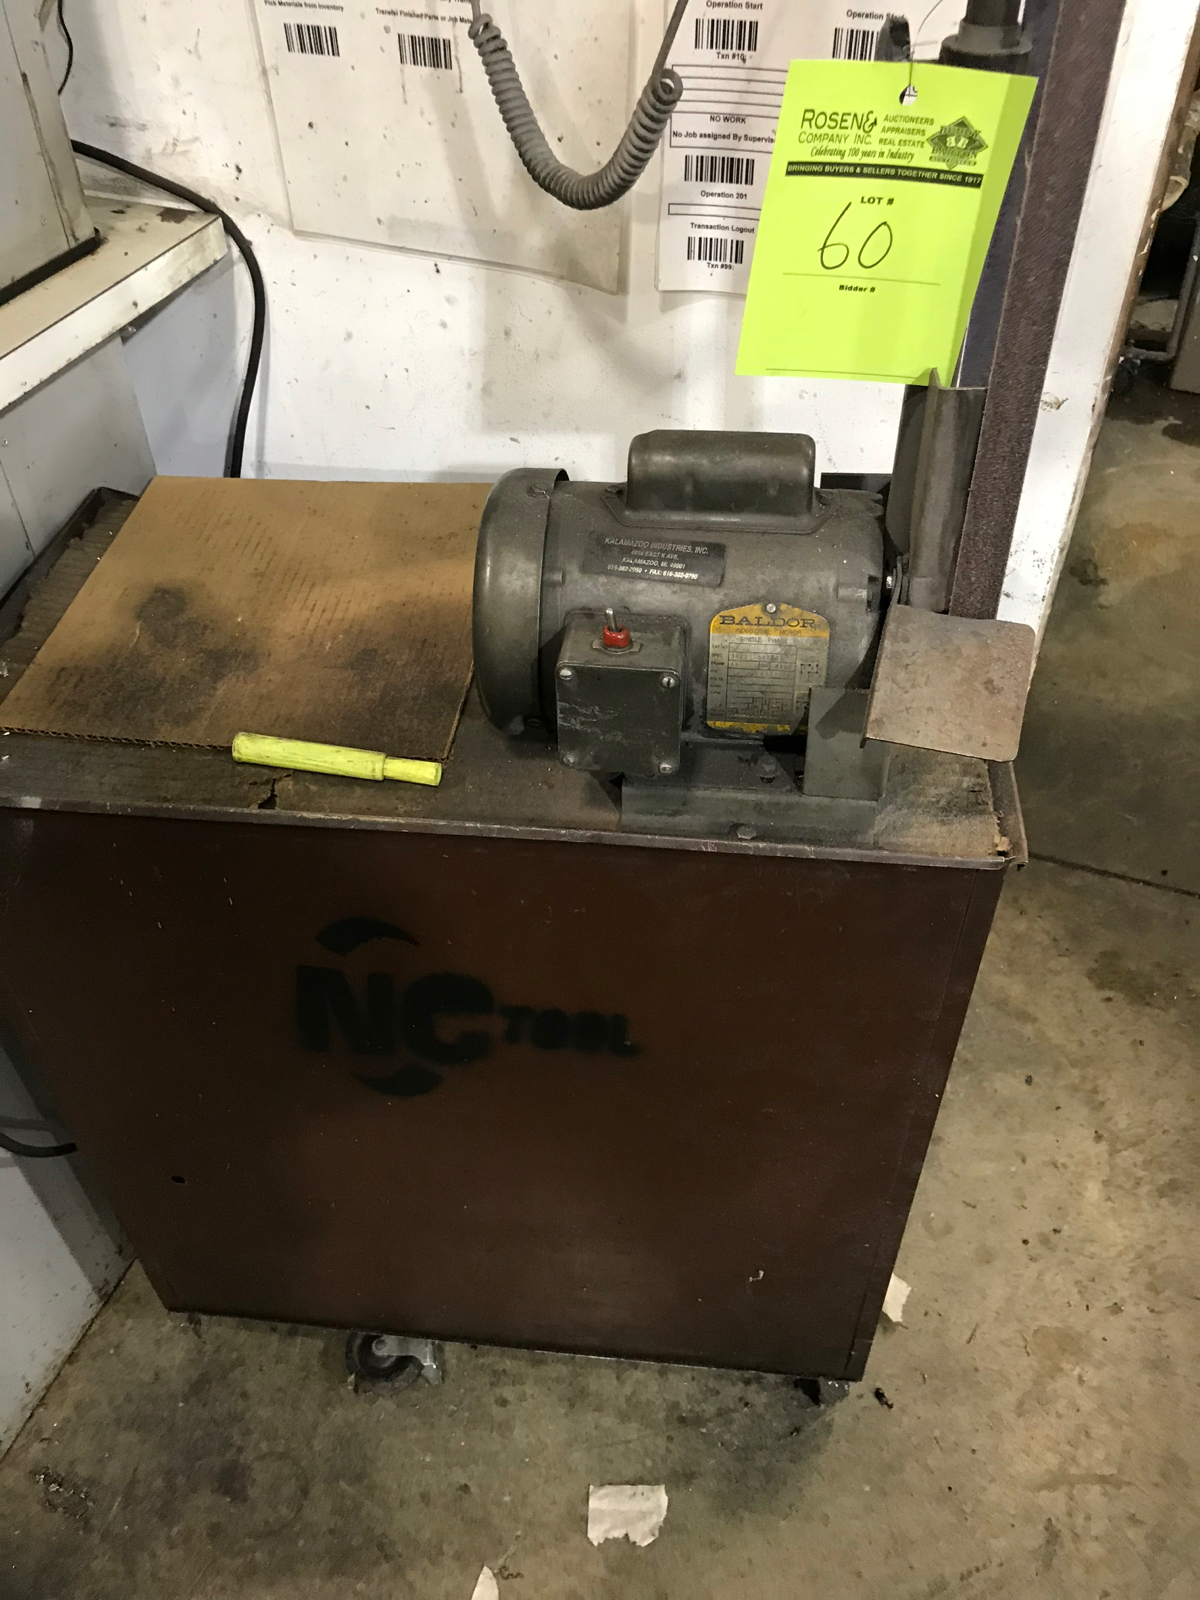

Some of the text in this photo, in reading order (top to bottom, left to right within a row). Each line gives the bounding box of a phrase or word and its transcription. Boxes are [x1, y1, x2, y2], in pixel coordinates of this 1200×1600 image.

[318, 3, 344, 12] Inventory
[706, 0, 763, 10] Operation Start
[400, 10, 424, 19] Finished
[846, 9, 884, 20] Operation
[717, 52, 730, 60] Txn
[722, 116, 746, 124] WORK
[883, 114, 935, 126] AUCTIONEERS
[881, 126, 926, 137] APPRAISERS
[699, 132, 731, 141] assigned
[732, 134, 742, 142] By
[744, 135, 775, 144] Supervis
[798, 131, 872, 146] COMPANY INC.
[878, 138, 925, 148] REAL ESTATE
[811, 145, 846, 160] Celebrating
[859, 149, 876, 161] years
[886, 148, 915, 164] Industry
[788, 164, 823, 172] BRINGING
[824, 165, 855, 173] BUYERS
[863, 167, 895, 175] SELLERS
[897, 169, 938, 180] TOGETHER
[939, 173, 962, 182] SINCE
[964, 176, 981, 184] 1917
[700, 190, 747, 200] Operation 201
[860, 196, 895, 206] LOT #
[690, 222, 755, 234] Transaction Logout
[817, 201, 893, 270] 60
[838, 284, 868, 293] Bidder
[604, 537, 650, 549] KALAMAZOO
[719, 615, 815, 629] BALDOR
[499, 1004, 643, 1058] TOOL
